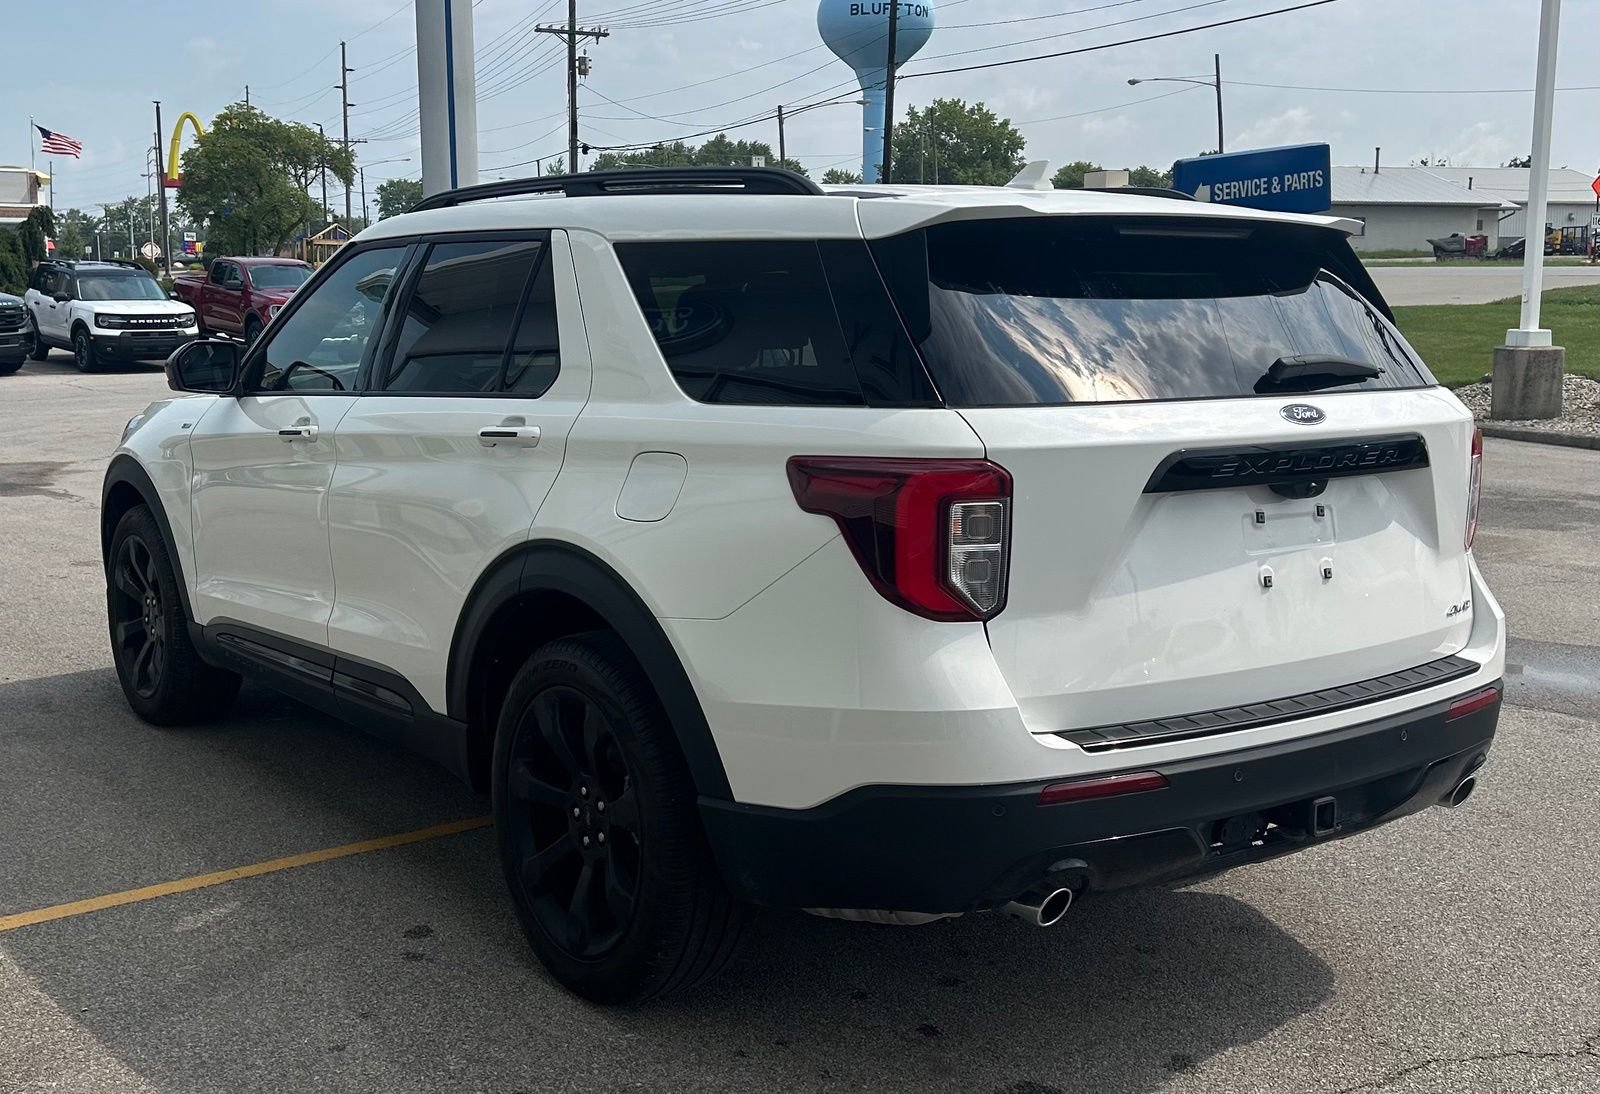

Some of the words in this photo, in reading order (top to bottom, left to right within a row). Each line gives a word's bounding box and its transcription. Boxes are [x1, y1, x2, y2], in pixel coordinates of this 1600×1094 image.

[1214, 177, 1268, 201] SERVICE
[1271, 176, 1281, 194] &
[1284, 170, 1324, 192] PARTS
[1293, 406, 1319, 419] Ford
[1211, 449, 1400, 478] EXPLORER
